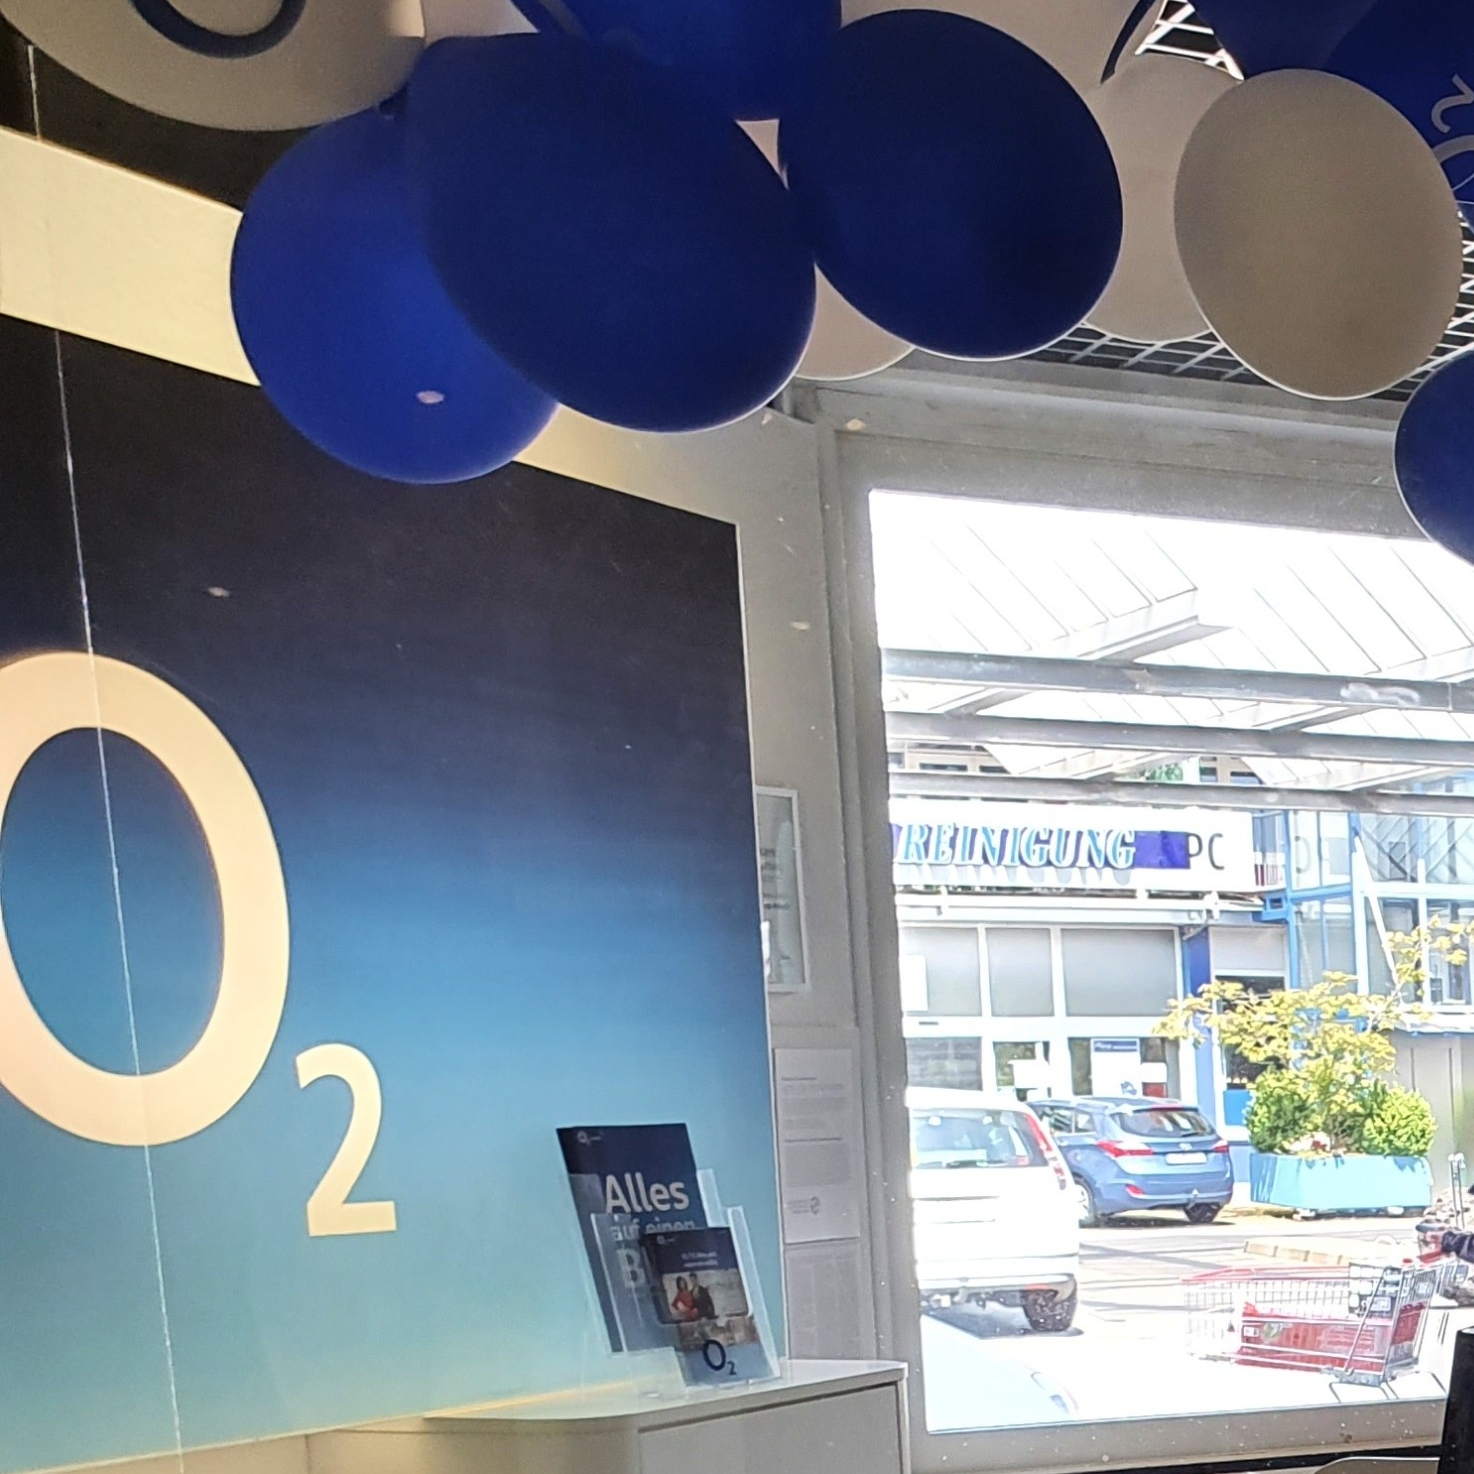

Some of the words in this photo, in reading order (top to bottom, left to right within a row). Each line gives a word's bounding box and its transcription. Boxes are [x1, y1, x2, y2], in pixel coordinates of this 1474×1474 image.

[896, 823, 1136, 869] REINIGUNG
[0, 652, 397, 1237] O2
[605, 1171, 690, 1214] Alles
[703, 1339, 738, 1376] O2
